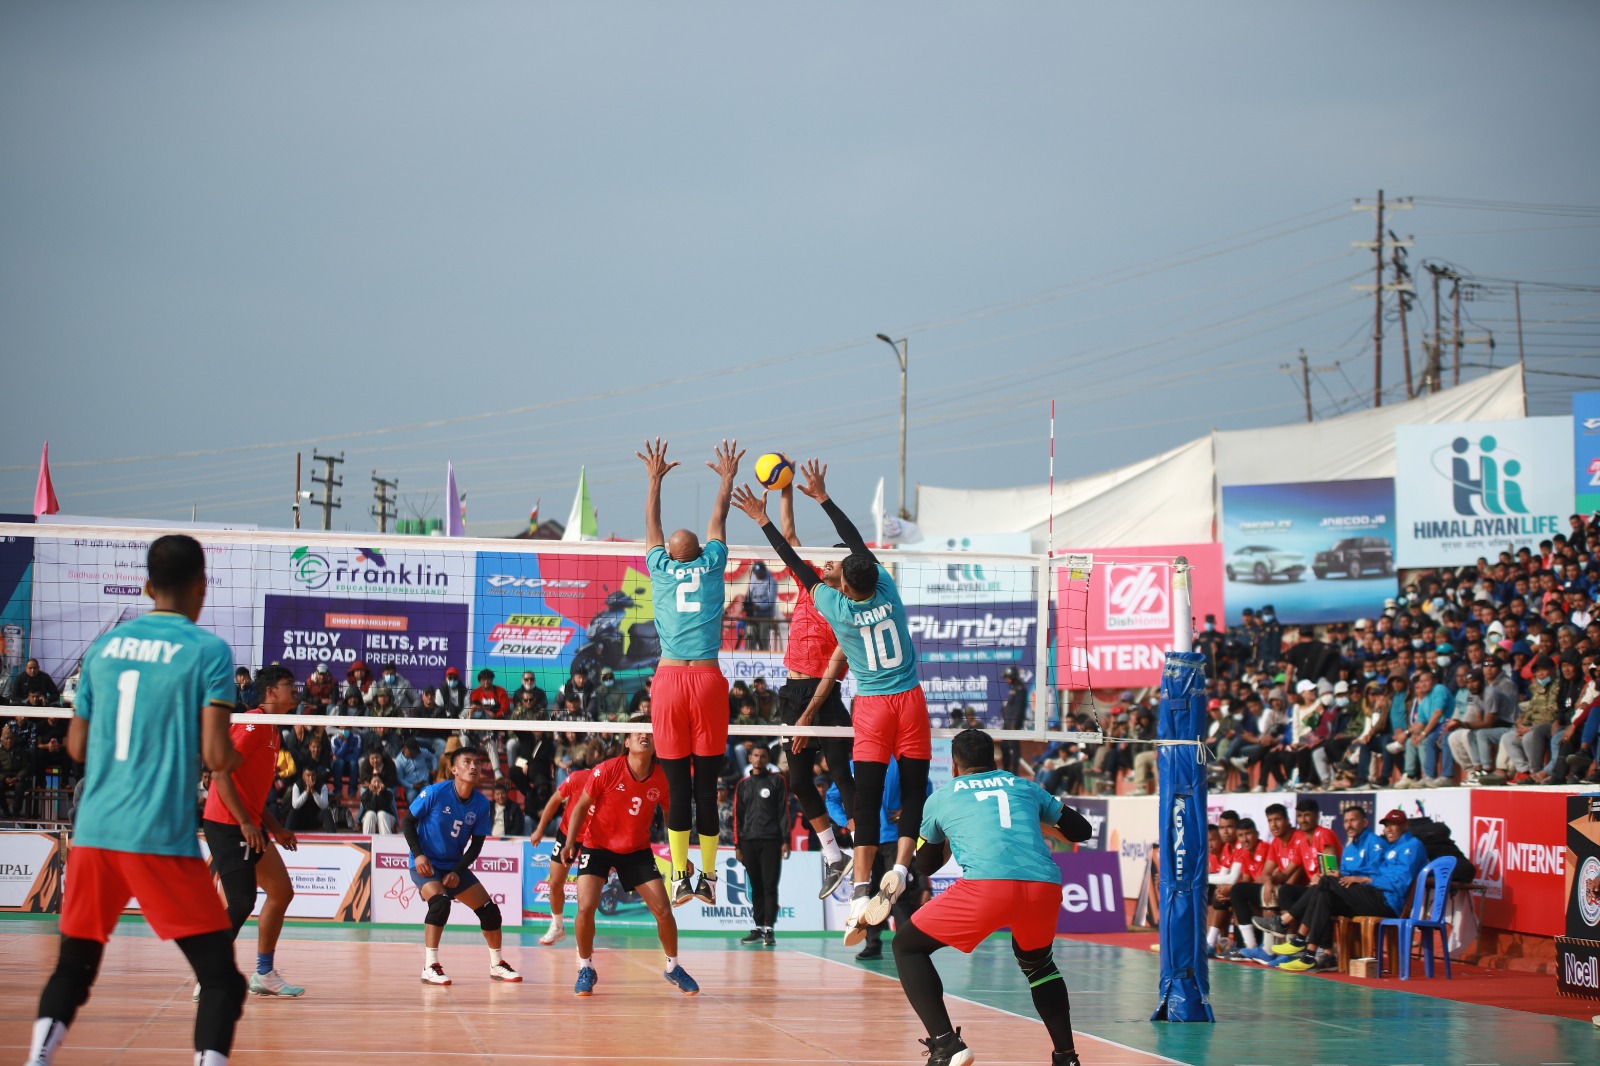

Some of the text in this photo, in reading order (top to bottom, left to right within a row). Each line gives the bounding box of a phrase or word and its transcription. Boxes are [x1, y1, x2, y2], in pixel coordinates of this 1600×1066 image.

[106, 587, 139, 596] NCELL APP
[336, 584, 449, 596] EDUCATION CONSULTANCY
[675, 572, 701, 613] 2
[509, 615, 558, 627] STYLE
[853, 602, 895, 627] ARMY
[1108, 615, 1168, 628] DishHome
[907, 612, 1037, 640] Plumber
[283, 630, 341, 646] STUDY
[418, 636, 449, 651] PTE
[859, 618, 904, 672] 10
[101, 636, 184, 664] ARMY
[282, 646, 357, 662] ABROAD
[499, 643, 557, 655] POWER
[365, 652, 447, 667] PREPERATION
[1072, 643, 1173, 673] INTERN
[115, 669, 141, 762] 1
[953, 776, 1016, 793] ARMY
[628, 796, 643, 816] 3
[974, 788, 1012, 829] 7
[450, 819, 464, 838] 5
[552, 841, 562, 857] 5
[579, 854, 591, 870] 3
[1506, 840, 1566, 876] INTERNE
[0, 864, 33, 876] IPAL
[1061, 873, 1116, 914] ell
[701, 906, 754, 918] HIMALAY
[1564, 952, 1599, 989] Ncell
